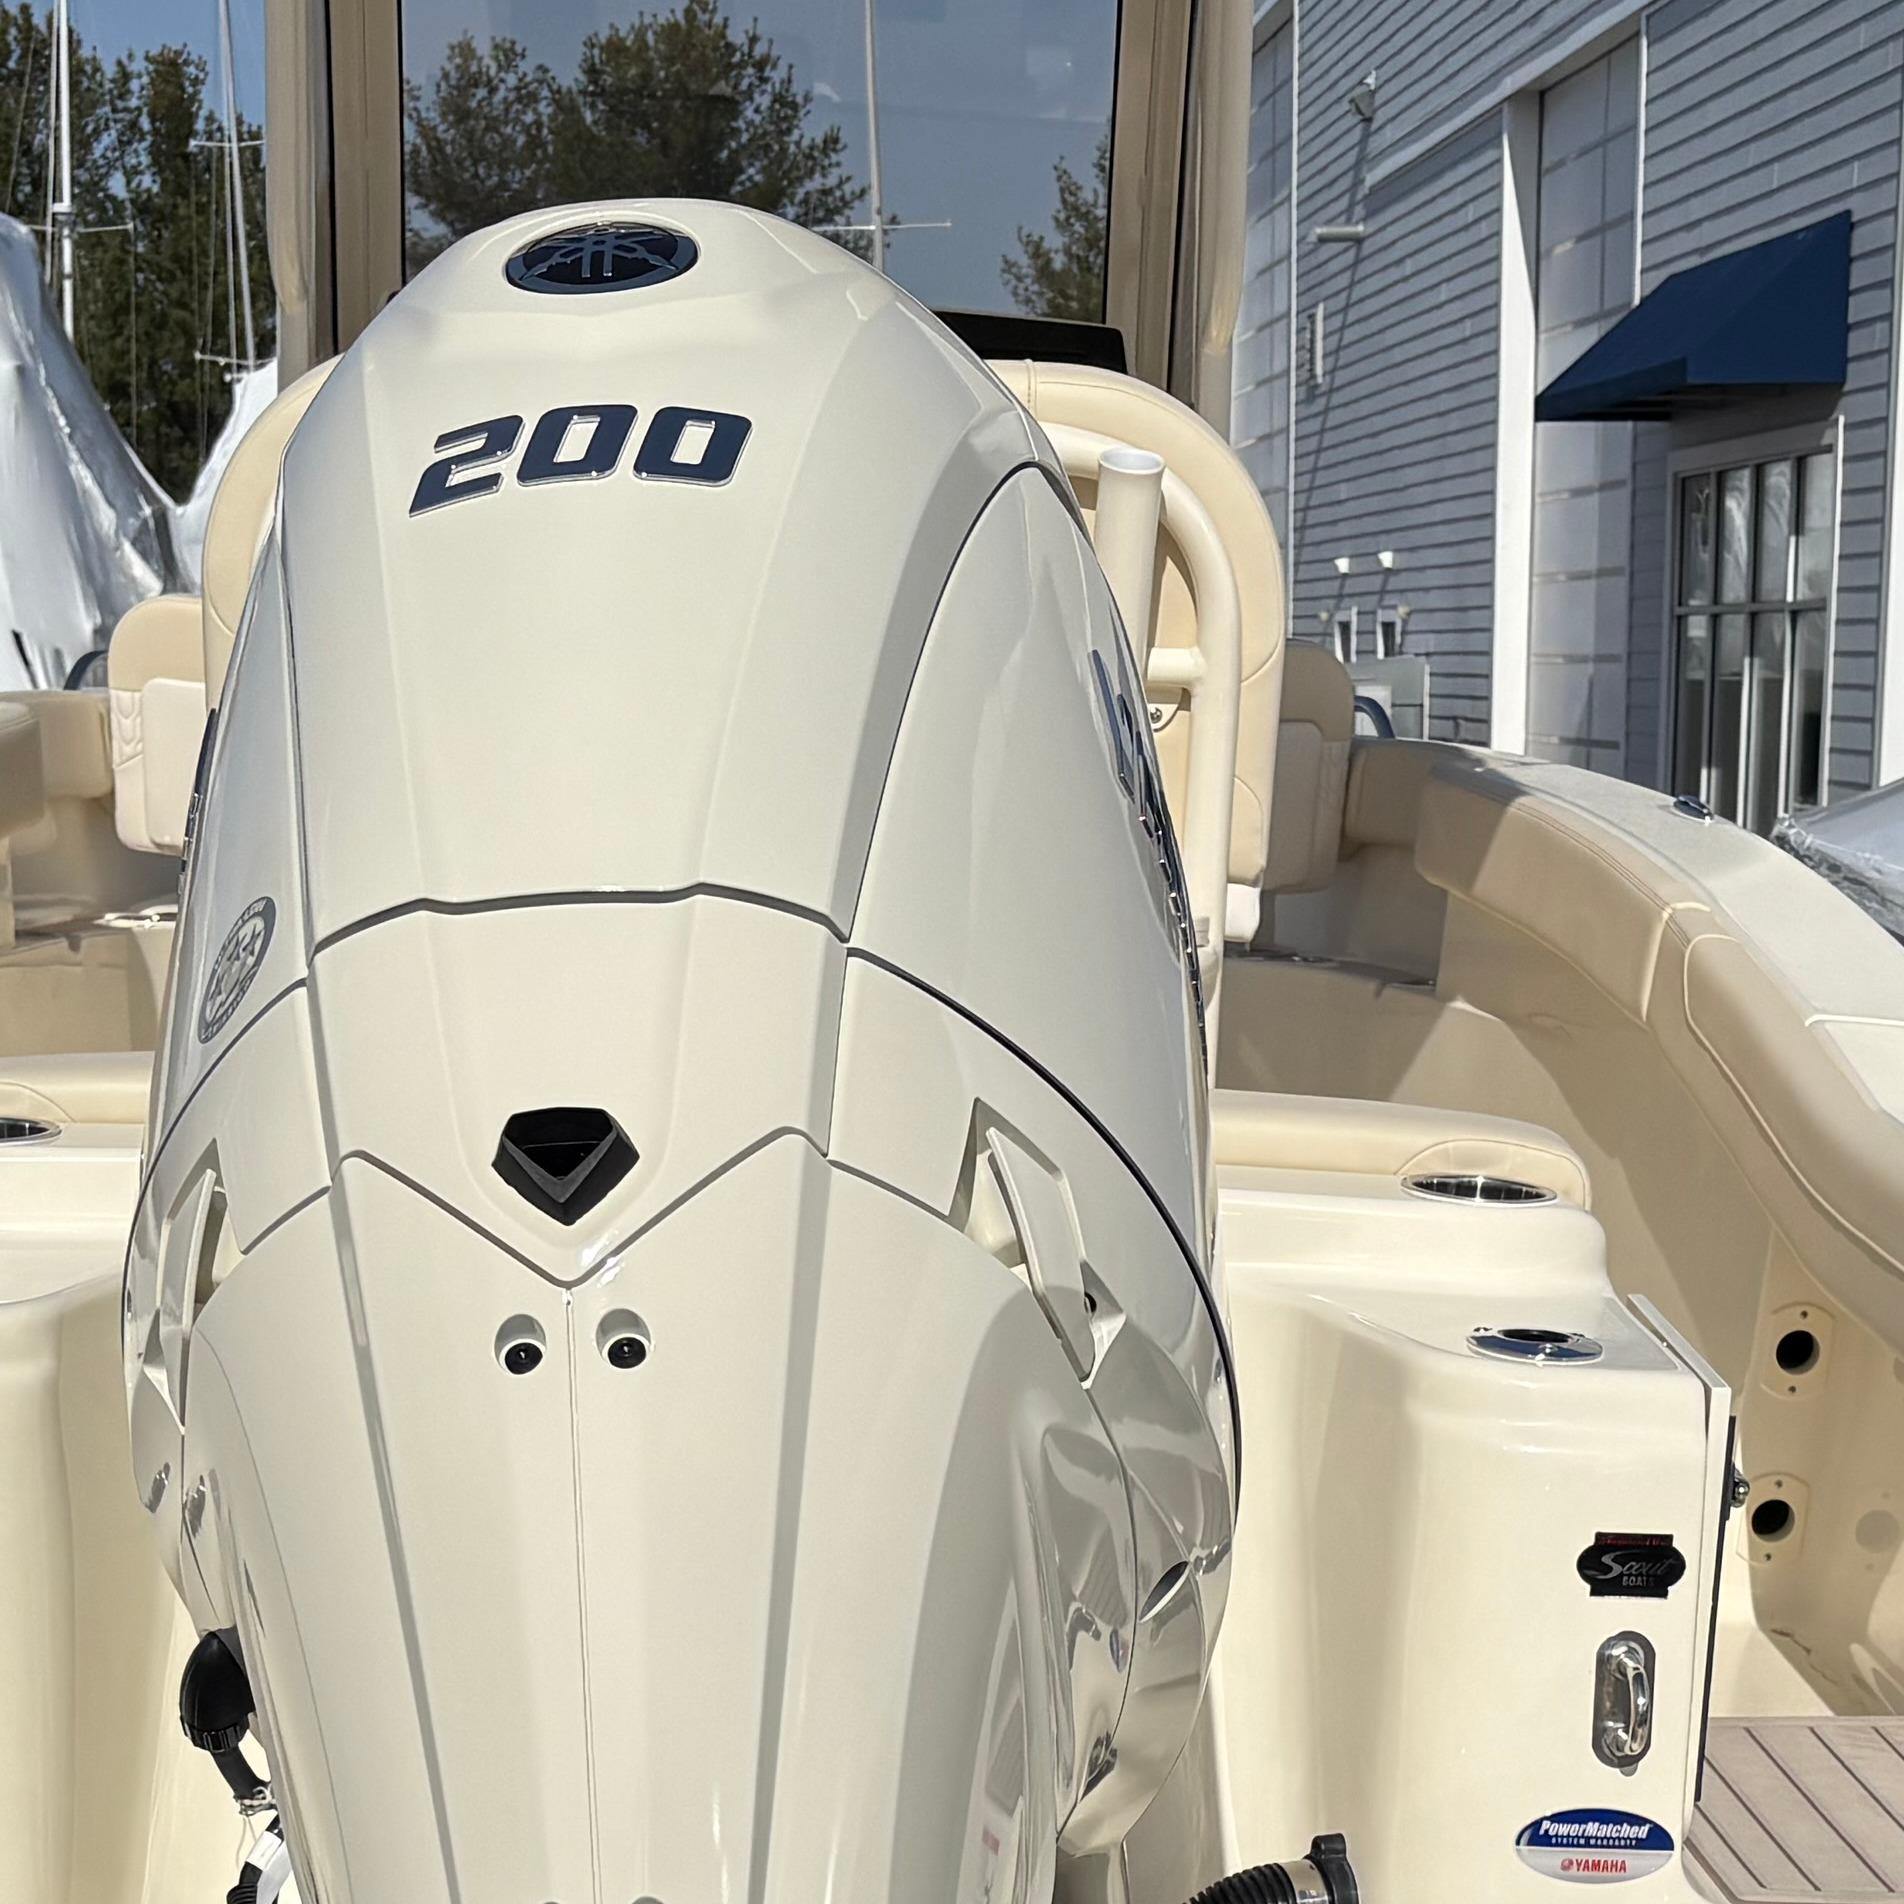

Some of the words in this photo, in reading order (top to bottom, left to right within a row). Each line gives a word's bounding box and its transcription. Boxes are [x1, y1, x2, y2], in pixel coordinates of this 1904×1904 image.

[409, 404, 753, 518] 200
[1582, 1549, 1681, 1580] Scout
[1539, 1820, 1649, 1840] PowerMatched
[1552, 1837, 1585, 1845] SYSTEM
[1590, 1838, 1636, 1847] WARRANTY
[1575, 1859, 1627, 1873] YAMAHA
